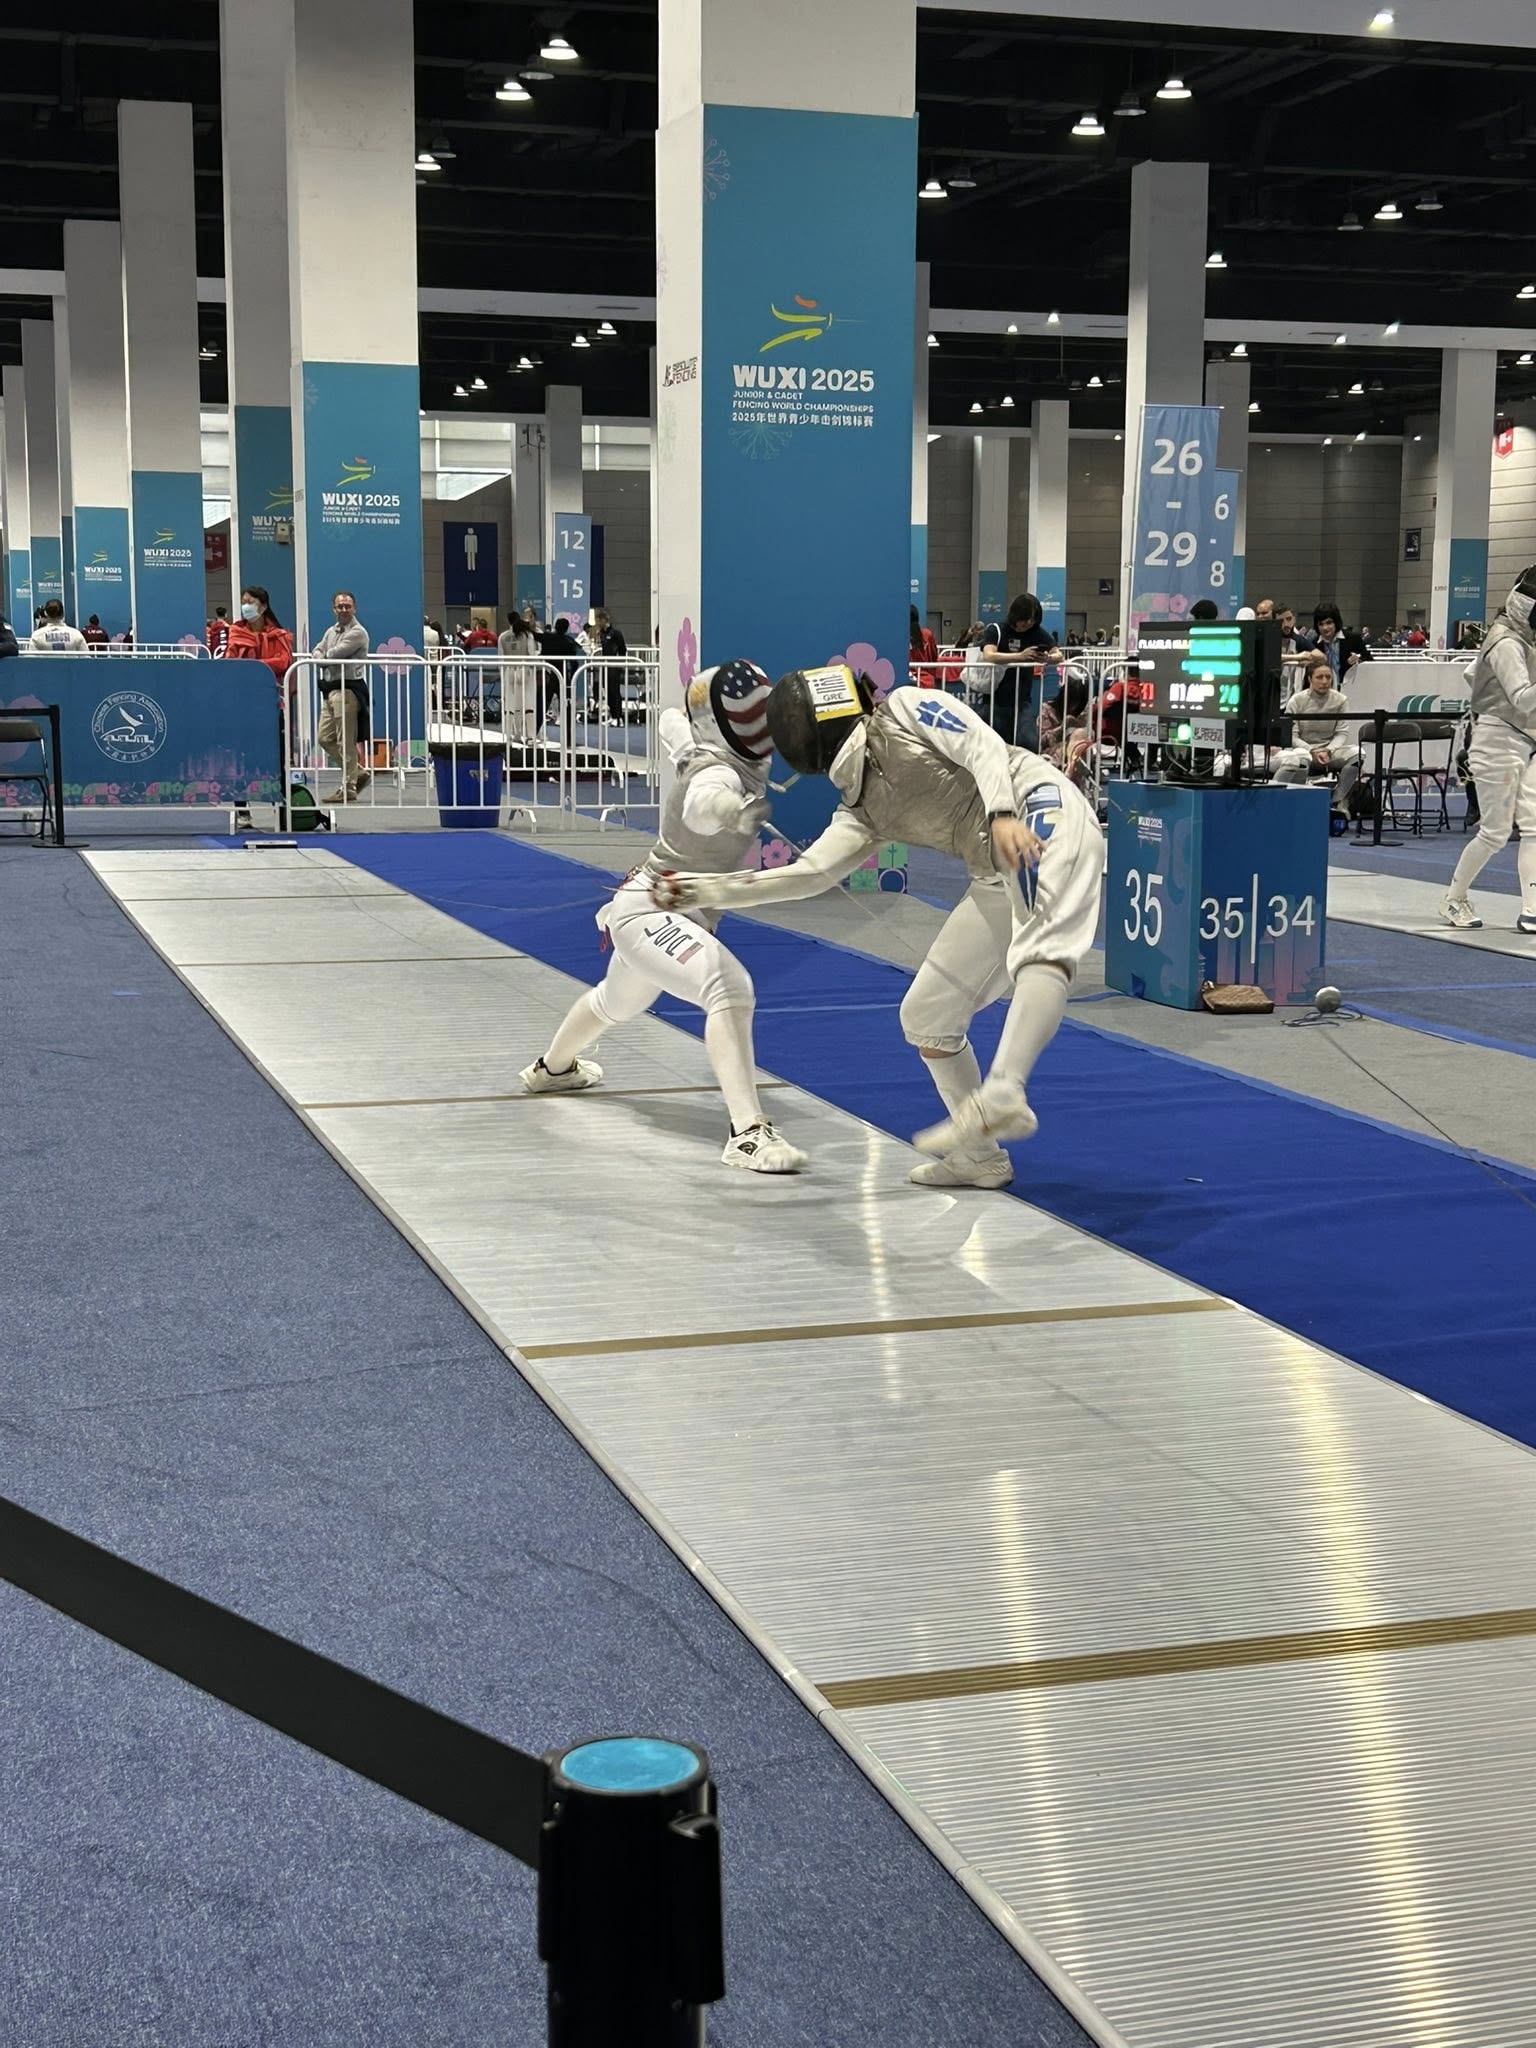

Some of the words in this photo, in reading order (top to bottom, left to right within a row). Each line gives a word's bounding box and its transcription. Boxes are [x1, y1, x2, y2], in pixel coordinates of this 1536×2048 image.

[733, 364, 806, 390] WUXI
[811, 368, 875, 392] 2025
[732, 400, 770, 409] FENCING
[772, 401, 803, 411] WORLD
[803, 402, 875, 413] CHAMPIONSHIPS
[733, 390, 764, 398] JUNIOR
[767, 391, 773, 399] &
[774, 391, 803, 400] CADET
[1150, 438, 1203, 476] 26
[322, 492, 362, 506] WUXI
[365, 494, 400, 507] 2025
[1214, 493, 1229, 520] 6
[560, 530, 584, 550] 12
[1144, 530, 1197, 567] 29
[143, 548, 169, 557] WUXI
[1210, 560, 1225, 587] 8
[559, 579, 584, 598] 15
[822, 691, 844, 702] GRE
[1124, 868, 1163, 947] 35
[1199, 897, 1244, 939] 35
[1266, 895, 1316, 937] 34
